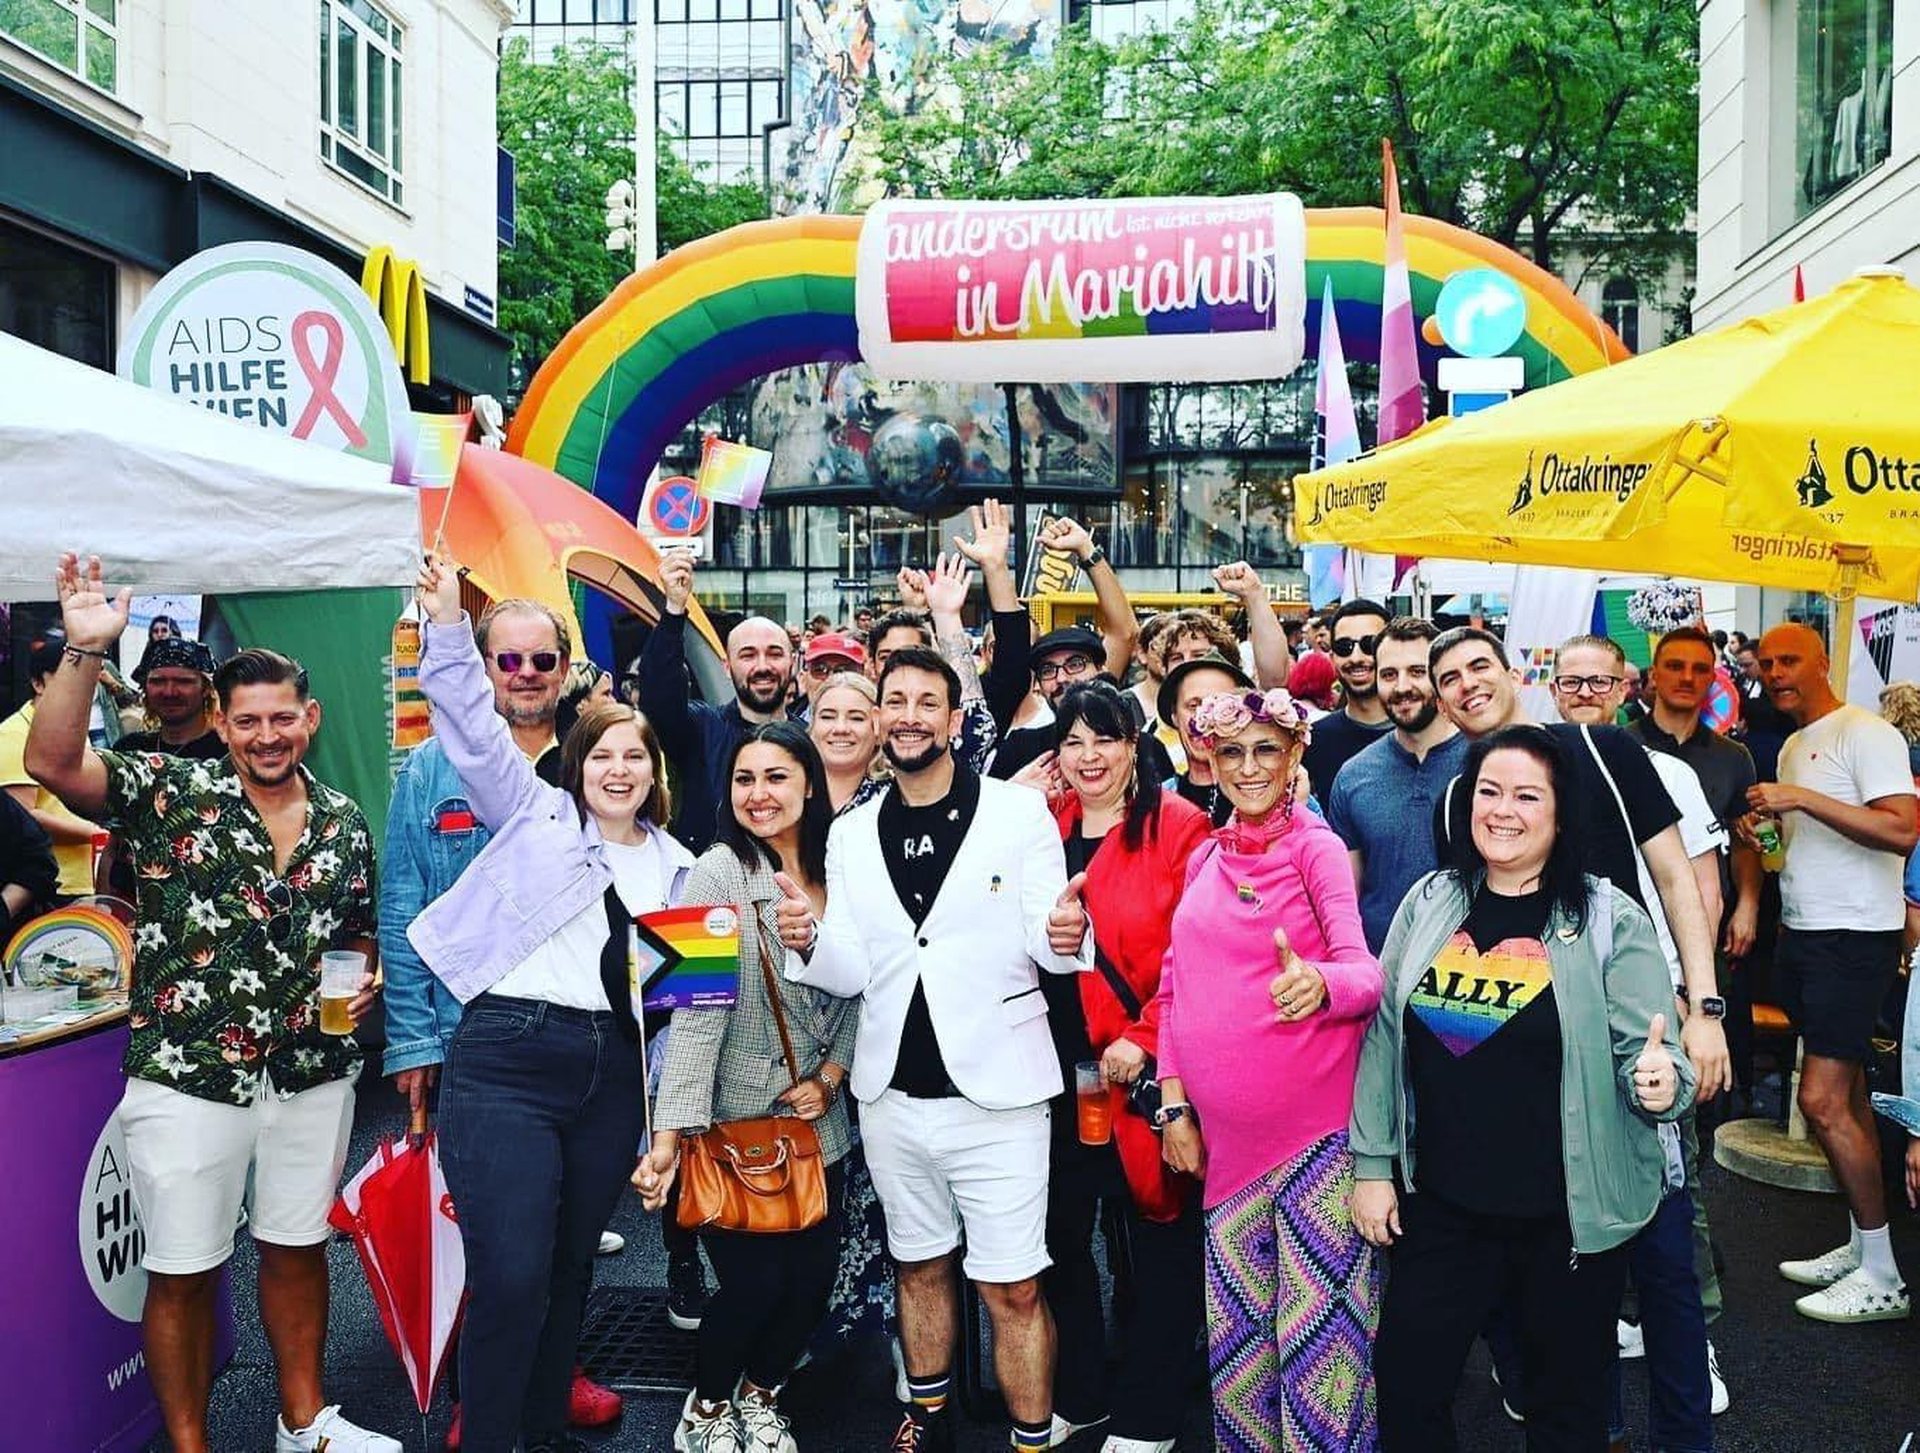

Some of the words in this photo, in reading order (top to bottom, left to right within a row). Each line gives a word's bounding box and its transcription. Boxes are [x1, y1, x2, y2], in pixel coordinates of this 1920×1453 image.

[886, 206, 1122, 263] andersrum
[957, 264, 1019, 337] in
[1017, 229, 1275, 334] Mariahilf
[169, 316, 282, 355] AIDS
[170, 360, 288, 393] HILFE
[190, 397, 287, 427] IEN
[1325, 478, 1388, 512] Ottakringer
[1540, 452, 1653, 503] Ottakringe
[1261, 584, 1304, 600] THE
[1412, 966, 1525, 1009] ALLY
[97, 1188, 138, 1240] HI
[97, 1228, 146, 1283] WI
